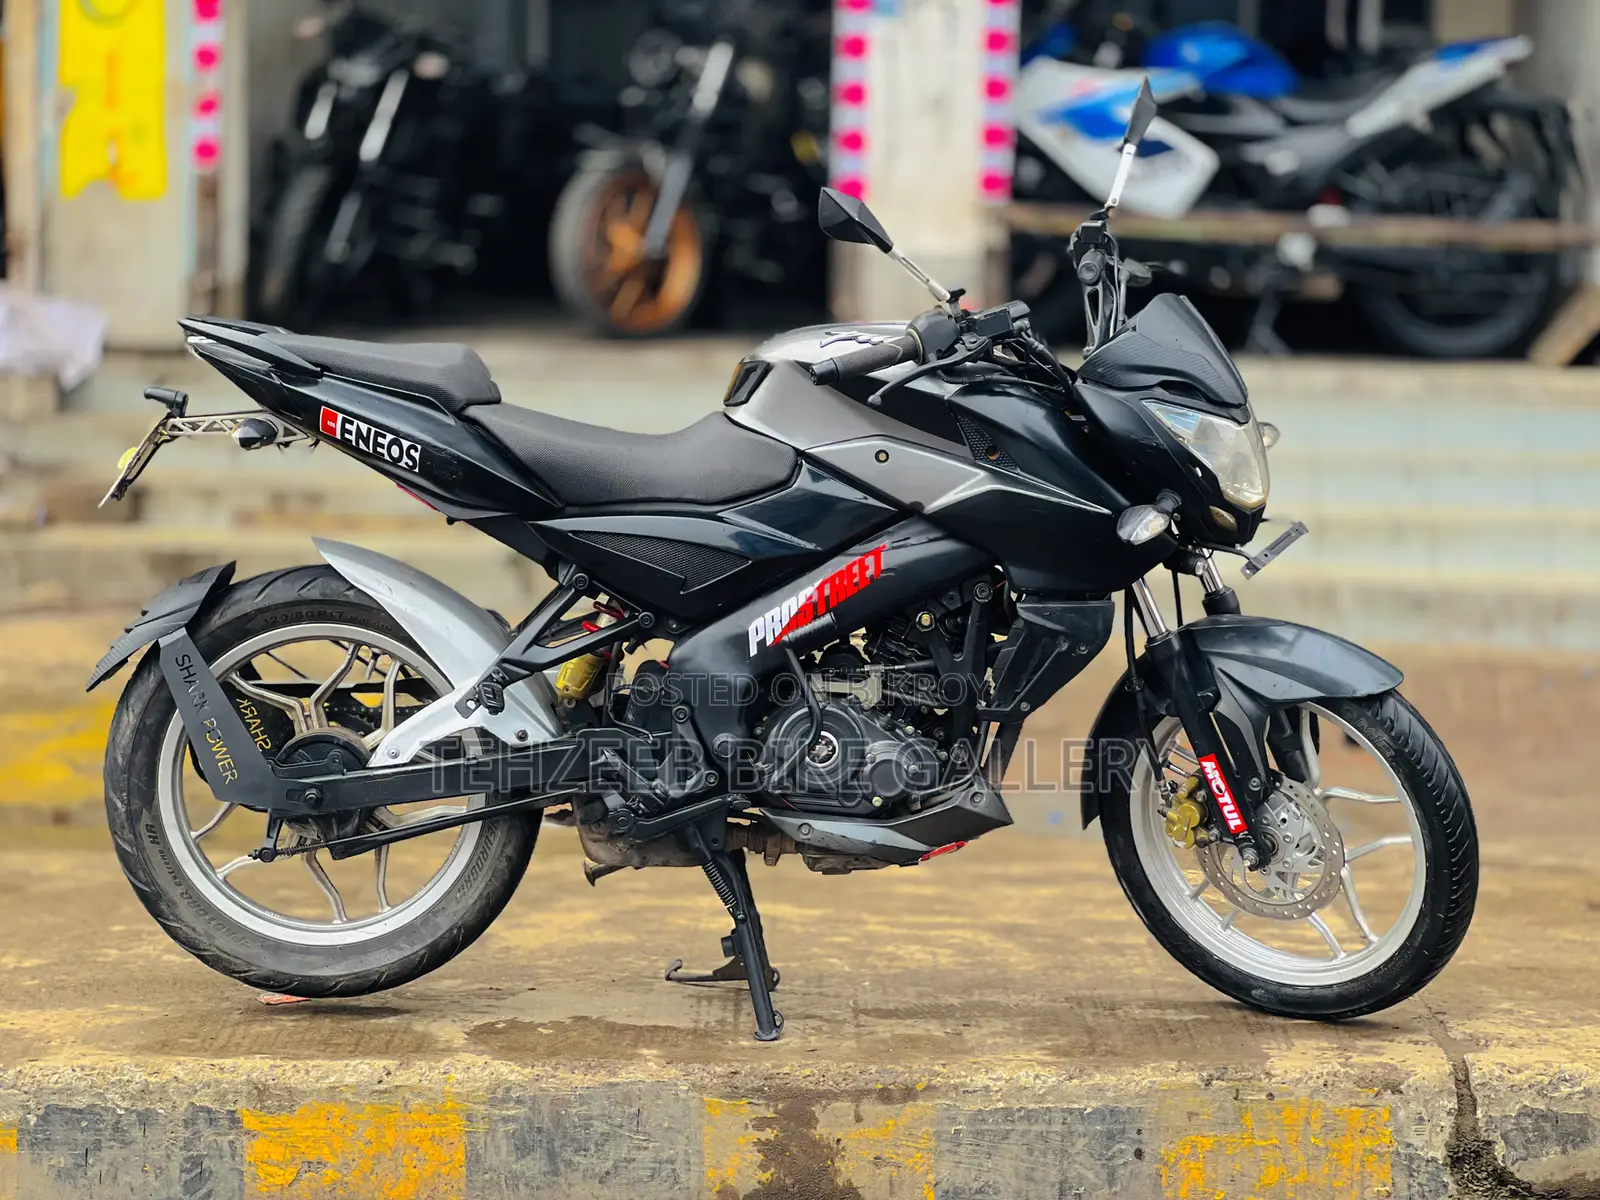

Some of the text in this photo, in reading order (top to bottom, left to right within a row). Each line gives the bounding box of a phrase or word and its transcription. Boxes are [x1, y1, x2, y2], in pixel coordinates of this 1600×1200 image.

[340, 415, 419, 471] ENEOS
[175, 654, 238, 785] SHARK POWER
[1201, 761, 1242, 830] MOTUL
